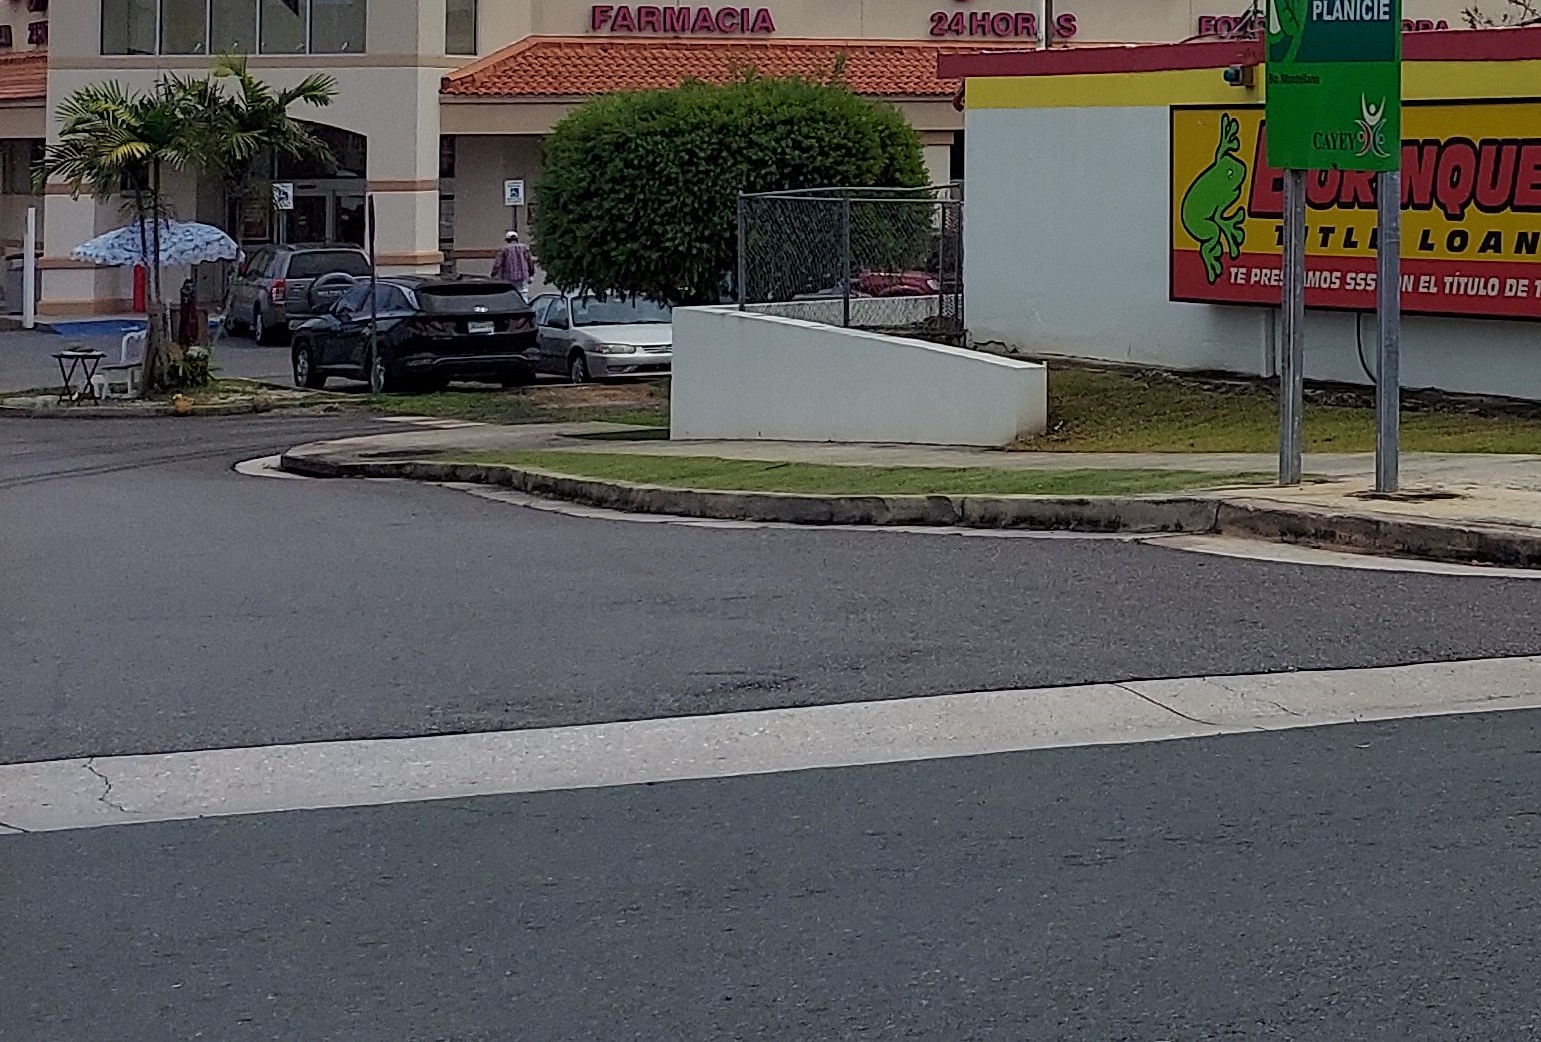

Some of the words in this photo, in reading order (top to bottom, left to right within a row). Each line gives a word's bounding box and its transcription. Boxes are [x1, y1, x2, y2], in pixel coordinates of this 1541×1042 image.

[591, 5, 776, 33] FARMACIA
[1312, 0, 1391, 21] PLANICIE
[930, 11, 966, 37] 24
[1313, 131, 1357, 150] CAYEY
[1229, 267, 1246, 285] TE
[1250, 268, 1341, 289] PRESMOS
[1418, 275, 1438, 294] EL
[1444, 271, 1500, 297] TÍTULO
[1504, 278, 1529, 298] DE
